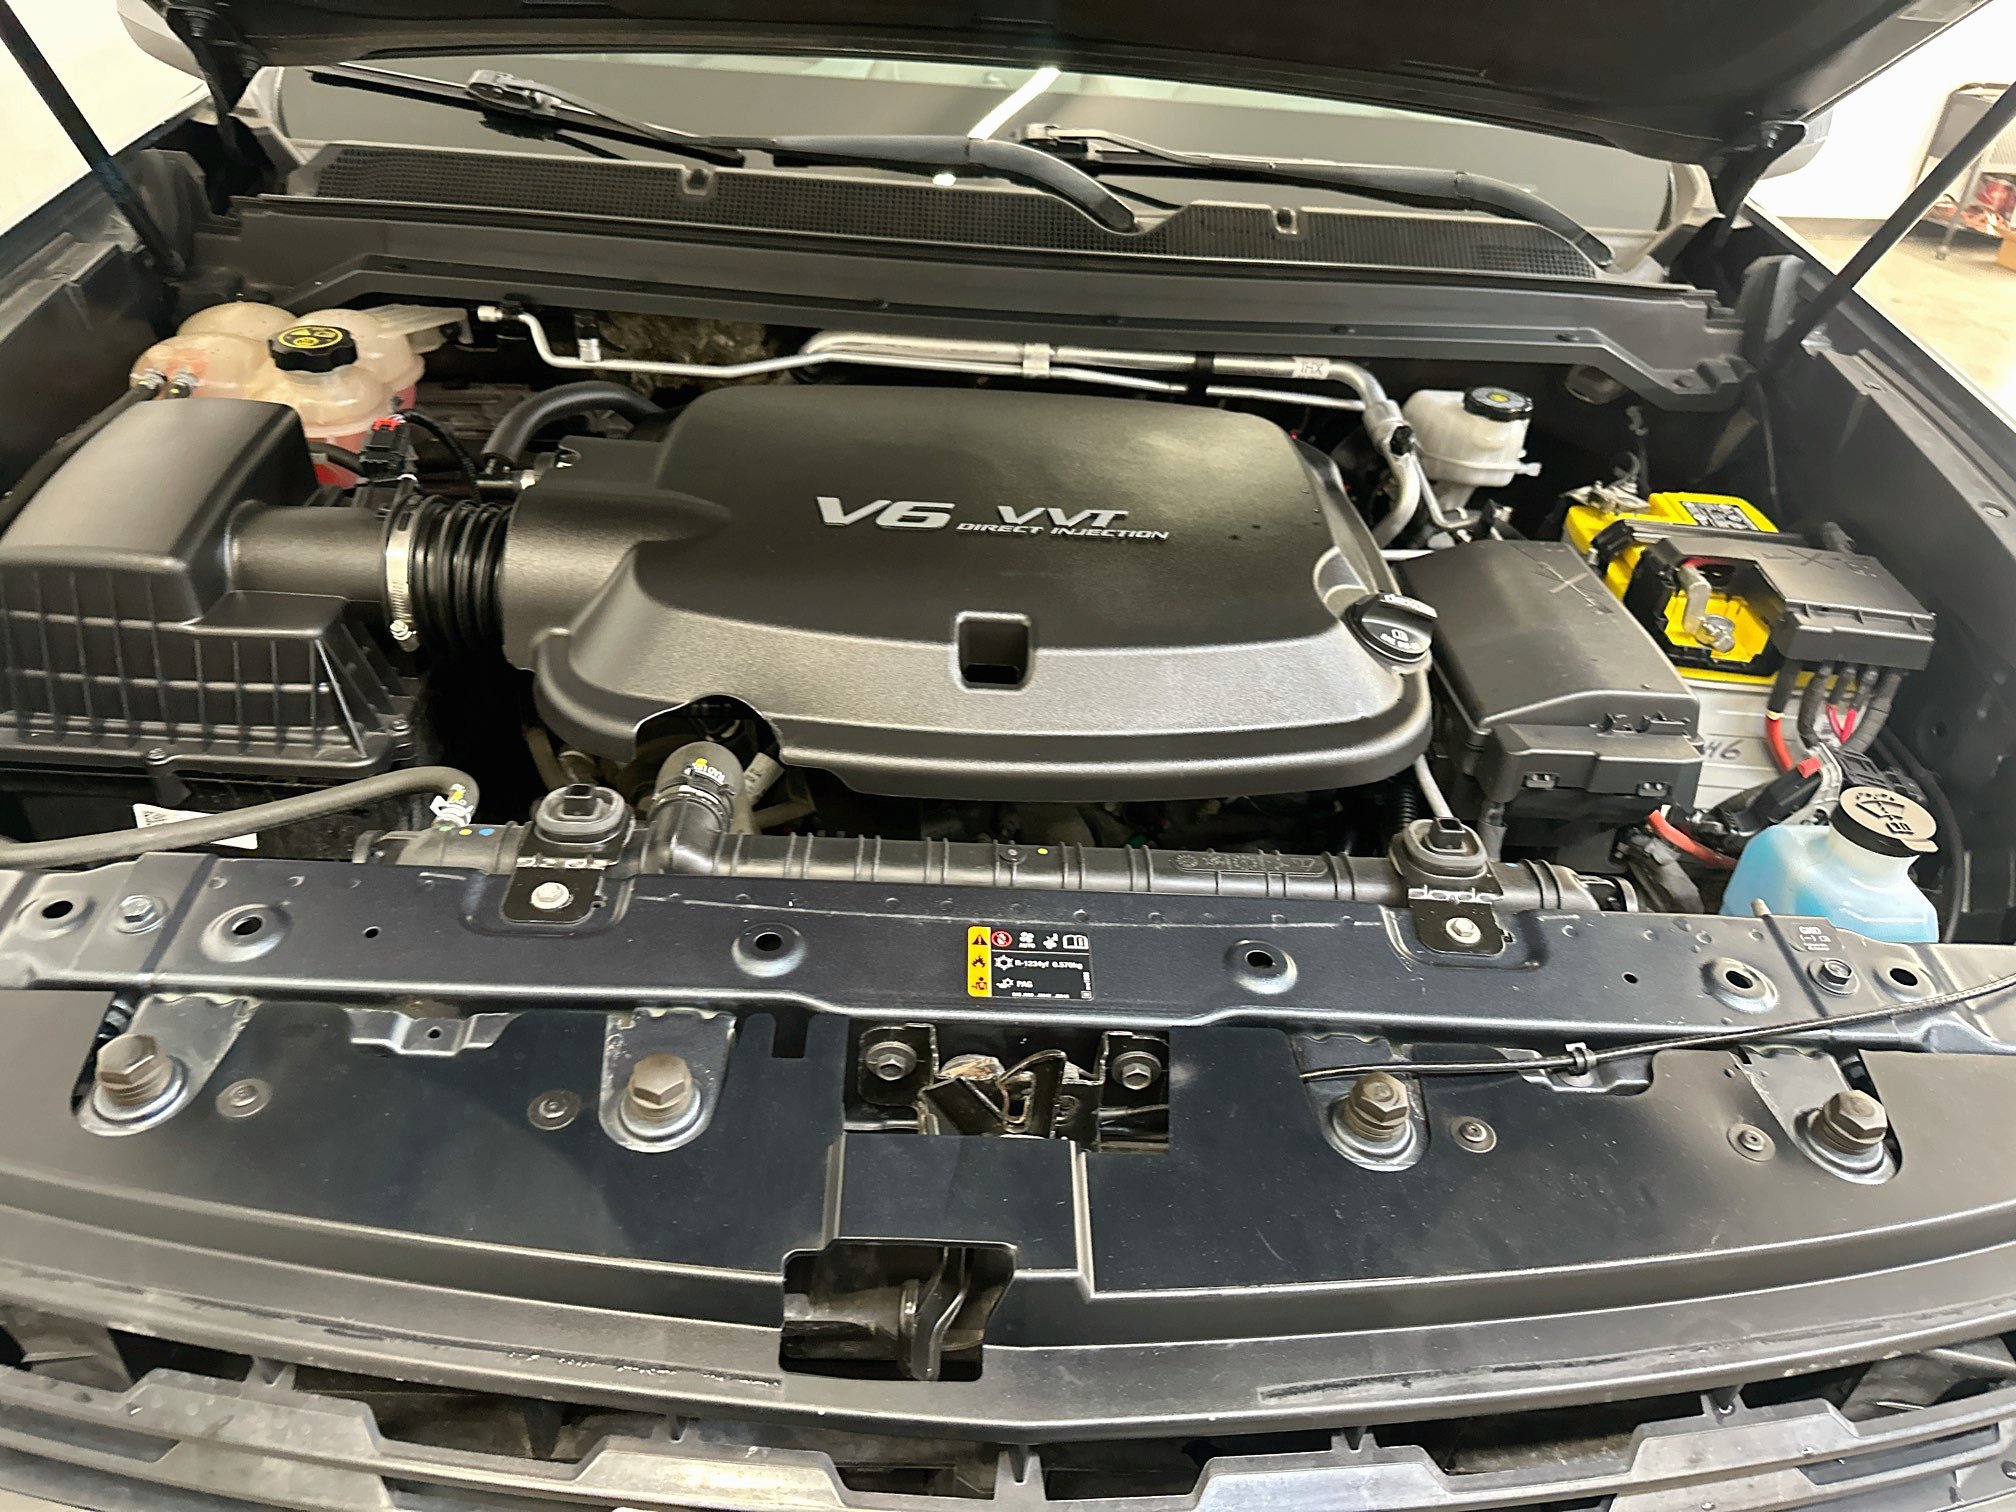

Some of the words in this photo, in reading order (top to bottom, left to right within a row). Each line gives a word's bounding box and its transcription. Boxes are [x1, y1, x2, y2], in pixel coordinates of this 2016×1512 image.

[816, 496, 955, 529] V6
[997, 505, 1129, 529] VVT
[955, 522, 1044, 535] DIRECT
[1050, 527, 1170, 541] INJECTION
[1016, 980, 1033, 988] PAG
